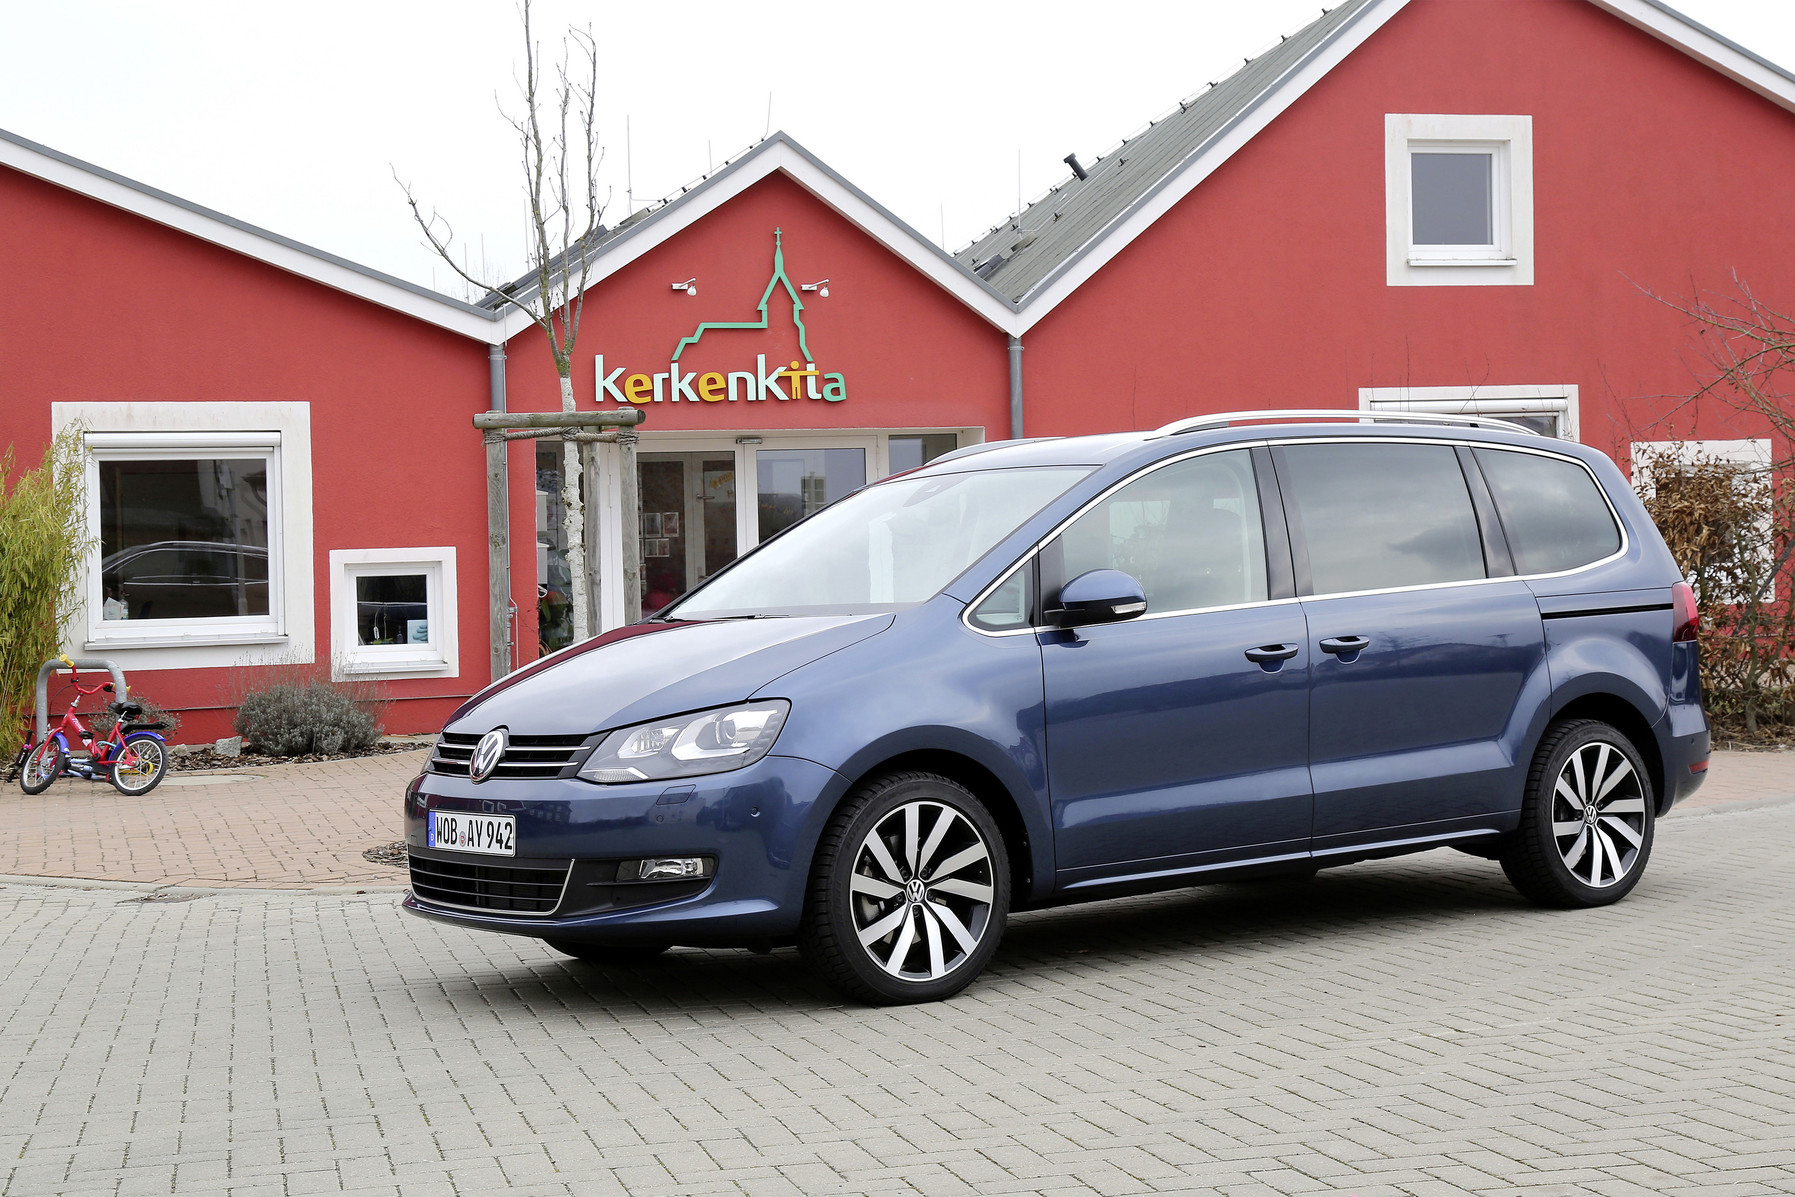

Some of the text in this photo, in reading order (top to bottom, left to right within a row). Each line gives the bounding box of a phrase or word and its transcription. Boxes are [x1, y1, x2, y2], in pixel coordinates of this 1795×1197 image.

[595, 354, 847, 404] kerkenkita
[436, 816, 513, 850] WOB AY 942
